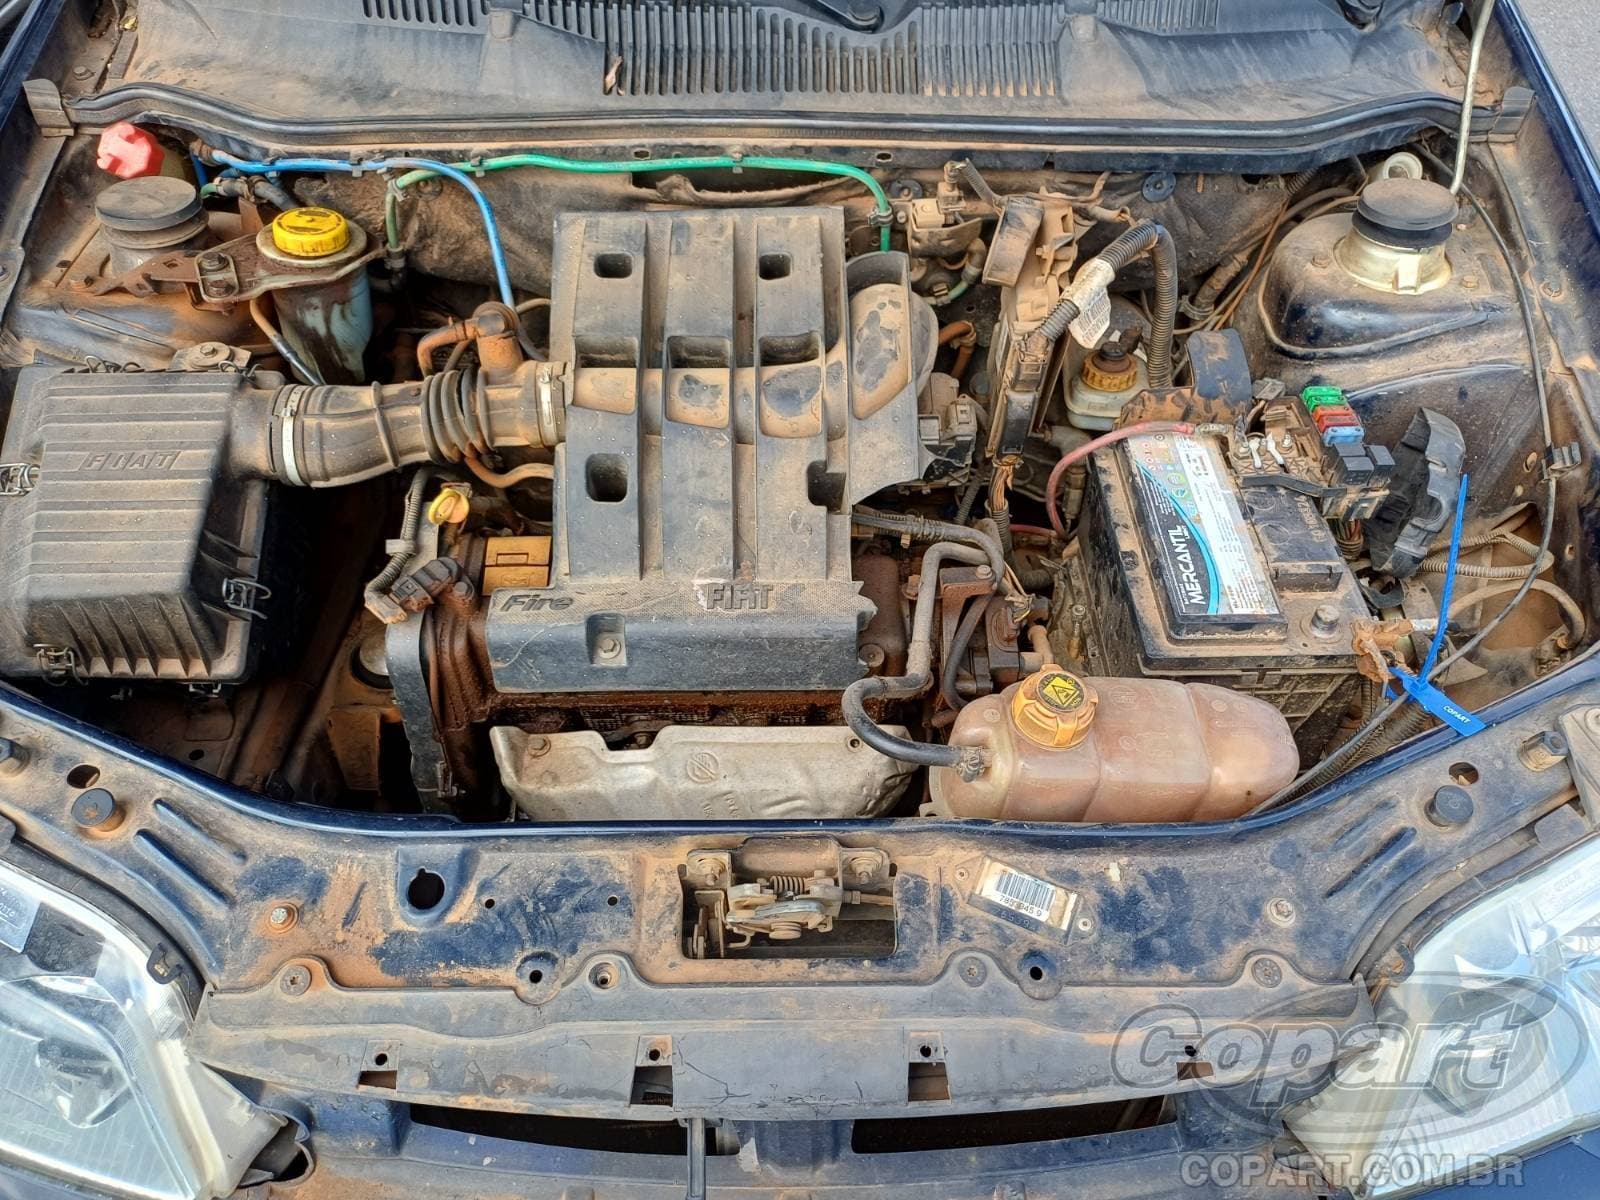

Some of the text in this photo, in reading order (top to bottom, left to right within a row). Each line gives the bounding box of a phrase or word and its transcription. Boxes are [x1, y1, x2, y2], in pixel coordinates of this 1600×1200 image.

[84, 452, 176, 469] FIAT
[1168, 525, 1206, 605] MERCANTIL
[500, 594, 574, 612] Fire
[705, 584, 773, 609] FIAT
[1443, 705, 1471, 724] COPART
